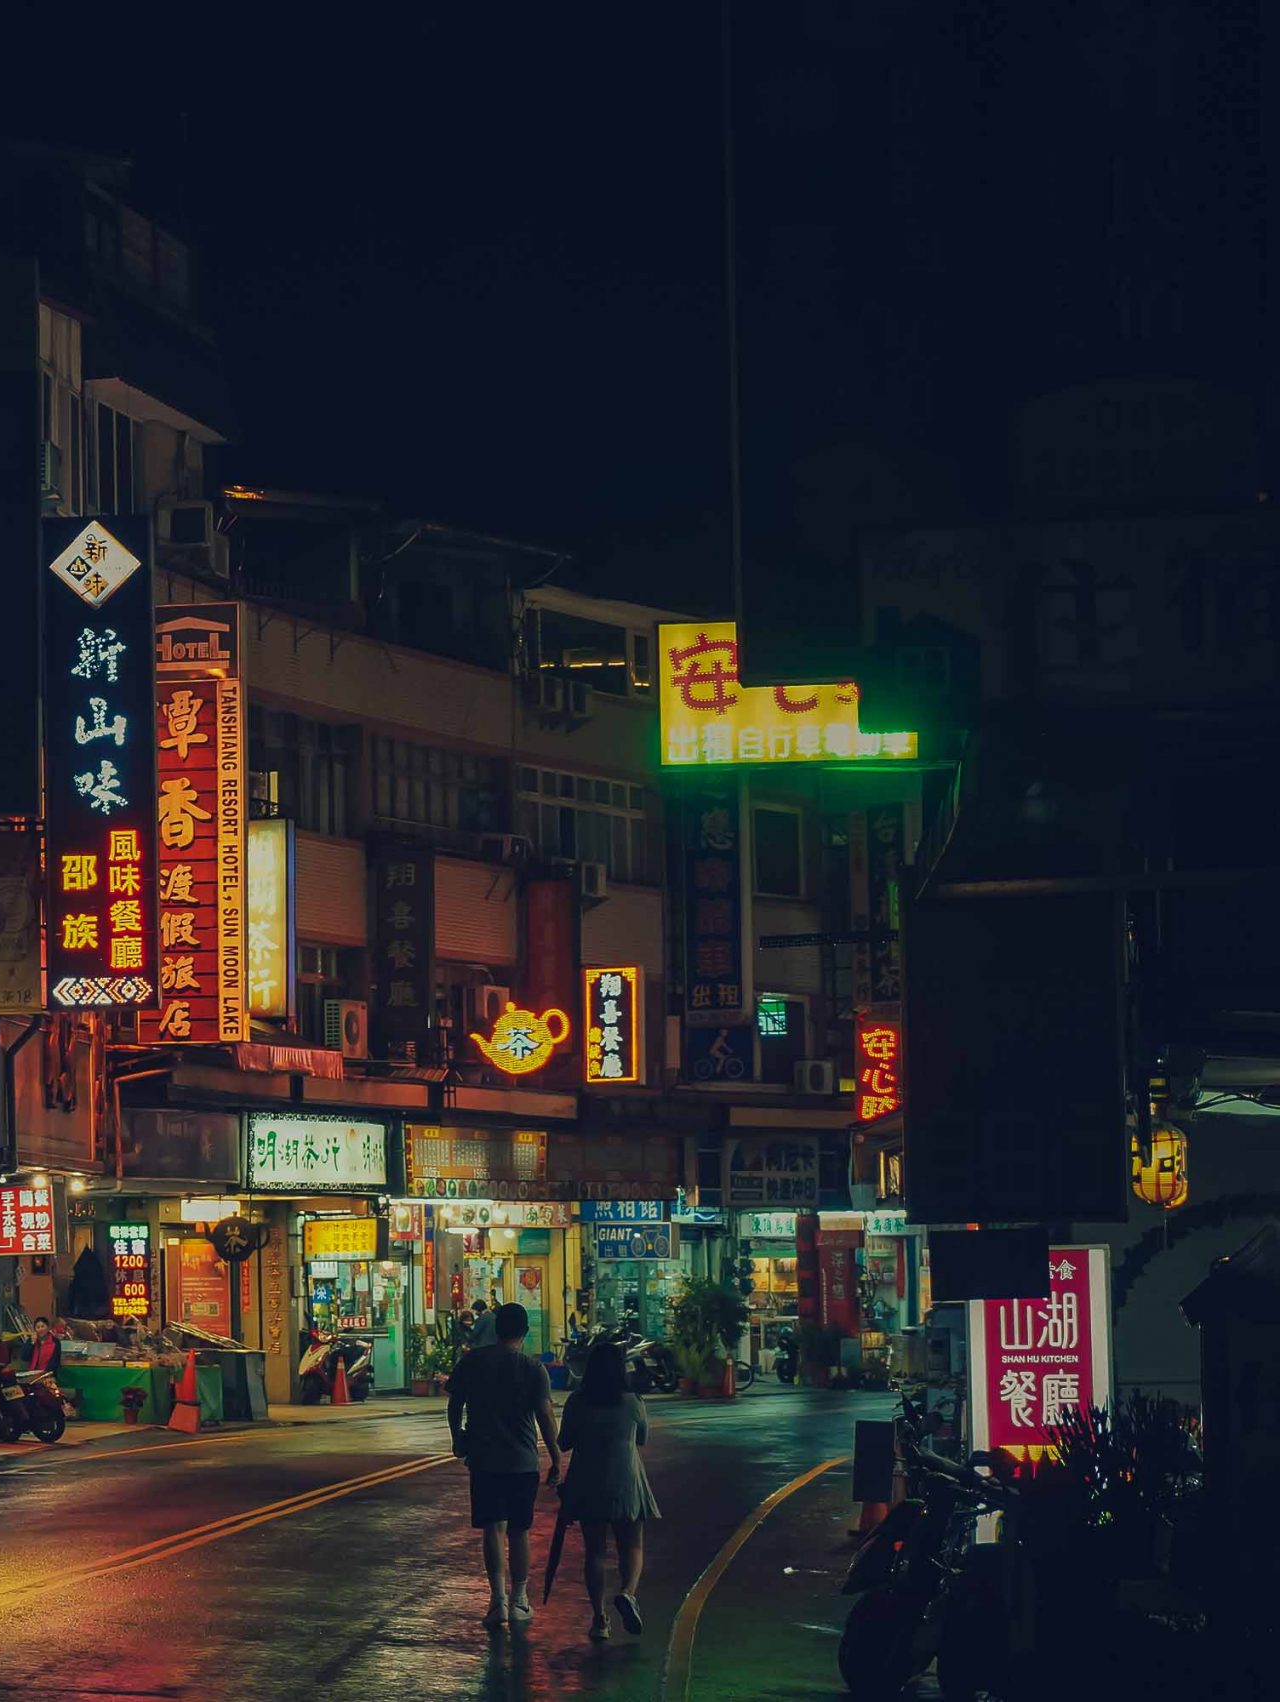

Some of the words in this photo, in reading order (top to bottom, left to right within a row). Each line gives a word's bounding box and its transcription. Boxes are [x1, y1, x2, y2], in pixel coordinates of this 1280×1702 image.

[156, 632, 231, 662] HOTEL
[220, 686, 238, 772] TANSHIANG
[221, 779, 239, 837] RESORT
[61, 854, 98, 949] 邵族
[108, 829, 143, 969] 風味餐廳
[223, 907, 240, 937] SUN
[223, 946, 240, 990] MOON
[692, 983, 740, 1009] 出租
[223, 997, 240, 1035] LAKE
[497, 1027, 542, 1060] 茶
[257, 1131, 341, 1172] 明湖茶行
[21, 1212, 50, 1229] 現炒
[594, 1201, 658, 1219] 照相館
[22, 1233, 51, 1251] 合菜
[114, 1239, 146, 1255] 住宿
[598, 1228, 633, 1241] GIANT
[114, 1256, 144, 1267] 1200
[124, 1284, 145, 1295] 600
[1000, 1291, 1079, 1350] 山湖
[1001, 1355, 1026, 1363] SHAN
[1027, 1355, 1040, 1363] HU
[1041, 1355, 1079, 1363] KITCHEN
[1000, 1368, 1080, 1428] 餐廳
